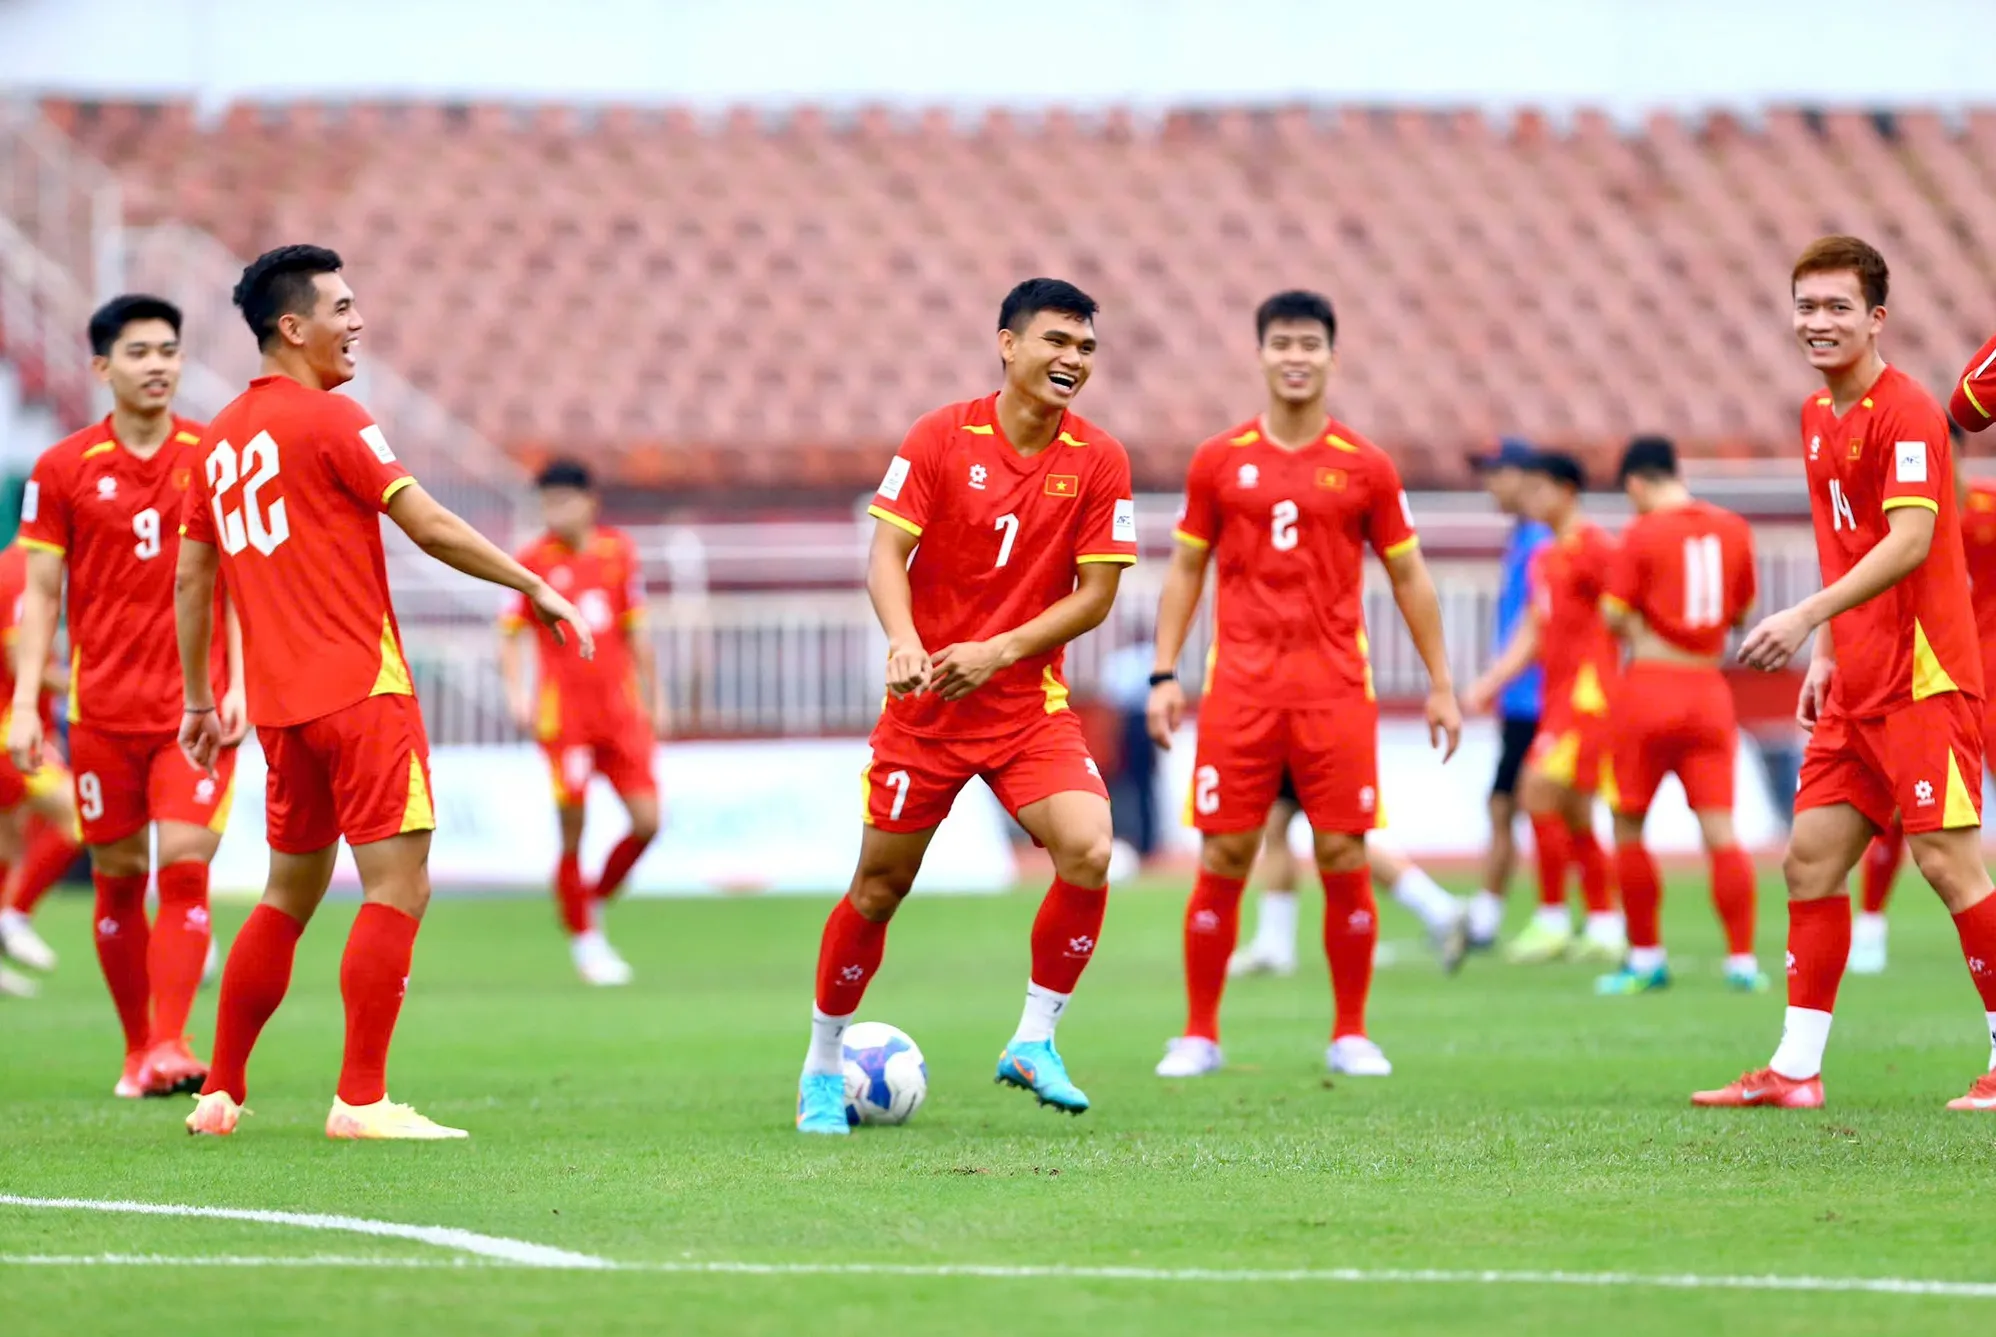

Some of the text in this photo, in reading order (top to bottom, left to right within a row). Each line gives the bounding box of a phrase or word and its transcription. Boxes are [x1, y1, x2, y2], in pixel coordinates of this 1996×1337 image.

[205, 429, 290, 557] 22
[1828, 478, 1858, 532] 14
[132, 507, 161, 560] 9
[994, 513, 1020, 568] 7
[1271, 499, 1298, 551] 2
[1683, 534, 1724, 632] 11
[78, 771, 103, 820] 9
[885, 770, 911, 820] 7
[1196, 765, 1220, 815] 2
[834, 1026, 844, 1037] 7
[1053, 1001, 1063, 1013] 7
